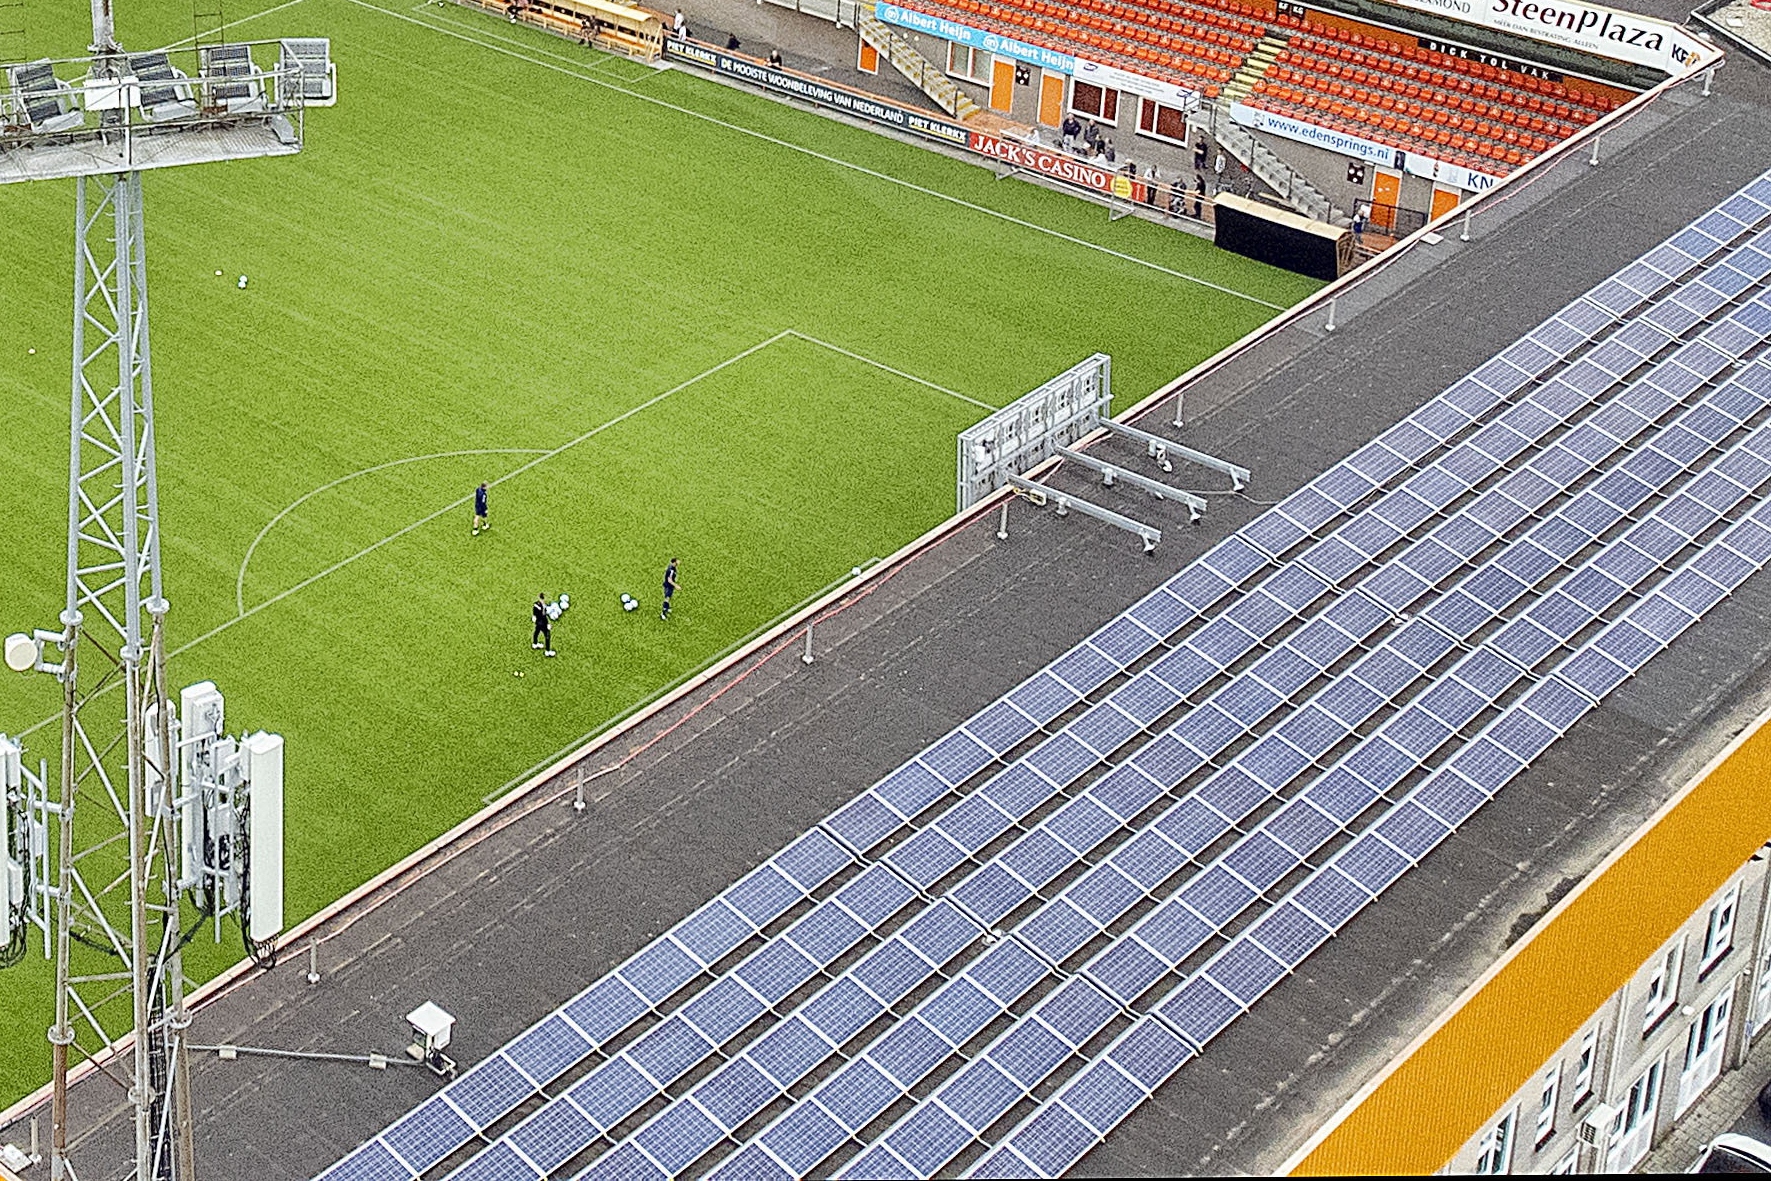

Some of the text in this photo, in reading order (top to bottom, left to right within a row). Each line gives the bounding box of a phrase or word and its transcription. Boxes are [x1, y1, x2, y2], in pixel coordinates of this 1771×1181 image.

[901, 9, 1074, 72] Albert Heijn Albert Heijn
[1429, 42, 1549, 80] DICK TOL VAK
[666, 40, 966, 142] PIET KLERKX DE MOOISTE WOONBELEVING VAN NEDERLAND PIET KLERKX
[974, 135, 1036, 166] JACK'S
[1038, 155, 1106, 189] CASINO
[1268, 118, 1389, 161] www.edensprings.nl
